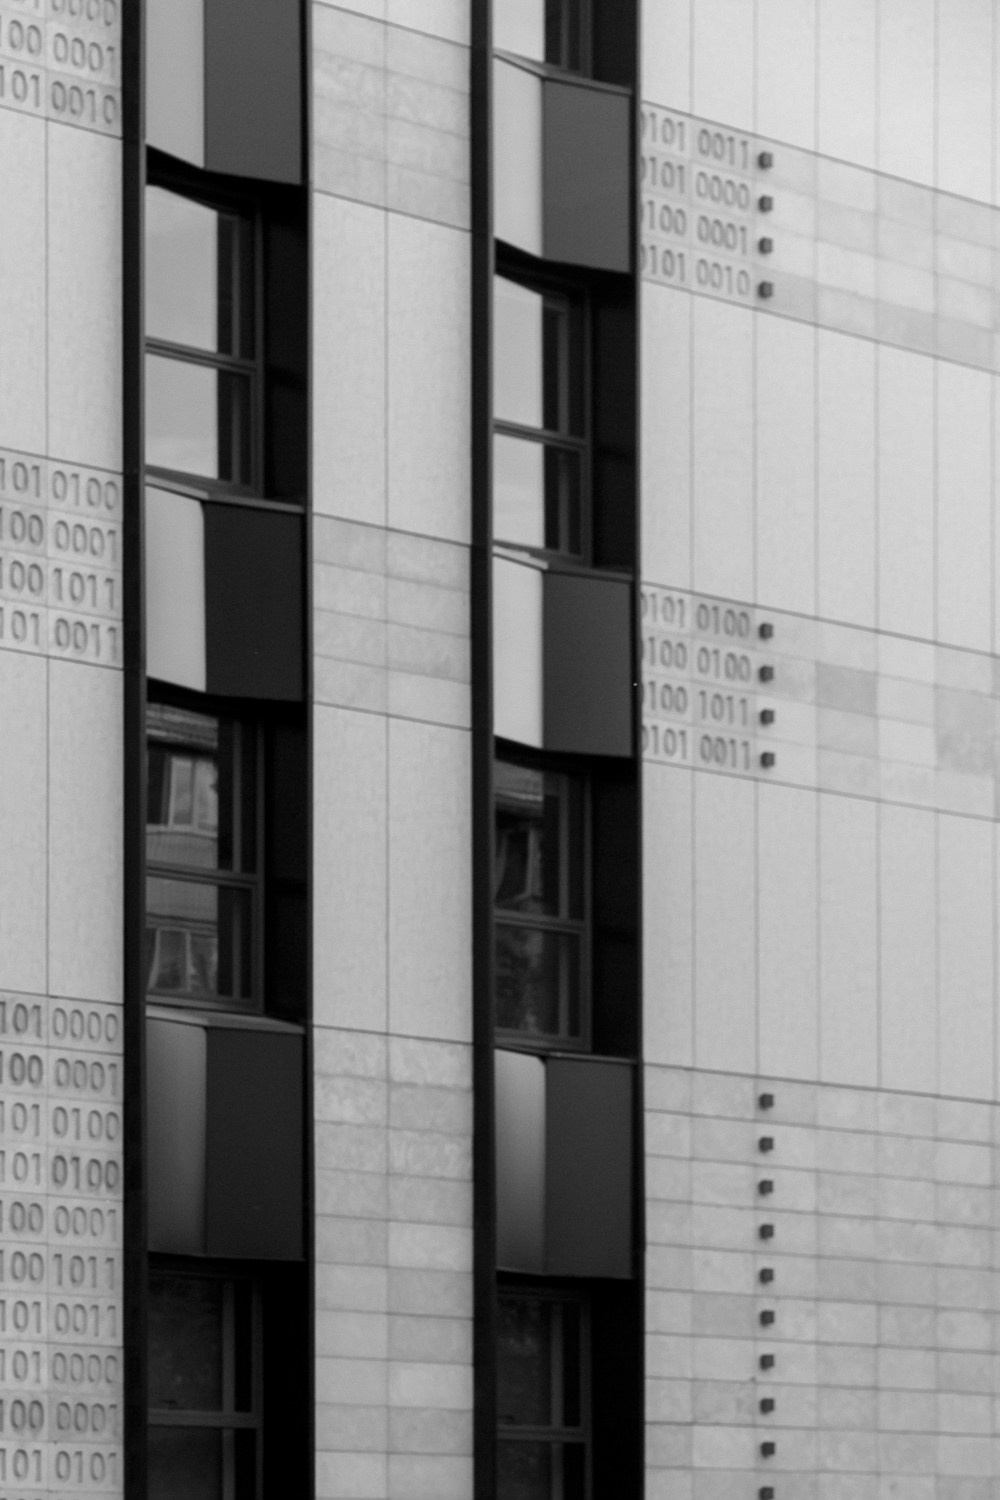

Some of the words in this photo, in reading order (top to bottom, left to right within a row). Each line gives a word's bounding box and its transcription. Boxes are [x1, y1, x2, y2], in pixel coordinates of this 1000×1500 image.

[54, 32, 115, 78] 0001
[51, 81, 117, 124] 0010
[698, 128, 748, 170] 0011
[696, 172, 750, 210] 0000
[641, 199, 687, 236] 100
[697, 216, 747, 255] 0001
[696, 258, 750, 296] 0010
[52, 470, 120, 510] 0100
[54, 520, 116, 562] 0001
[54, 568, 114, 610] 1011
[54, 618, 117, 660] 0011
[696, 604, 750, 638] 0100
[642, 636, 688, 670] 100
[697, 647, 750, 682] 0100
[642, 680, 688, 714] 100
[699, 690, 748, 726] 1011
[700, 734, 749, 770] 0011
[52, 1008, 118, 1042] 0000
[56, 1058, 118, 1096] 0001
[52, 1106, 120, 1140] 0100
[52, 1155, 120, 1189] 0100
[54, 1205, 117, 1242] 0001
[54, 1254, 114, 1290] 1011
[54, 1302, 116, 1338] 0011
[52, 1352, 118, 1384] 0000
[56, 1402, 118, 1437] 0001
[56, 1450, 117, 1485] 0101
